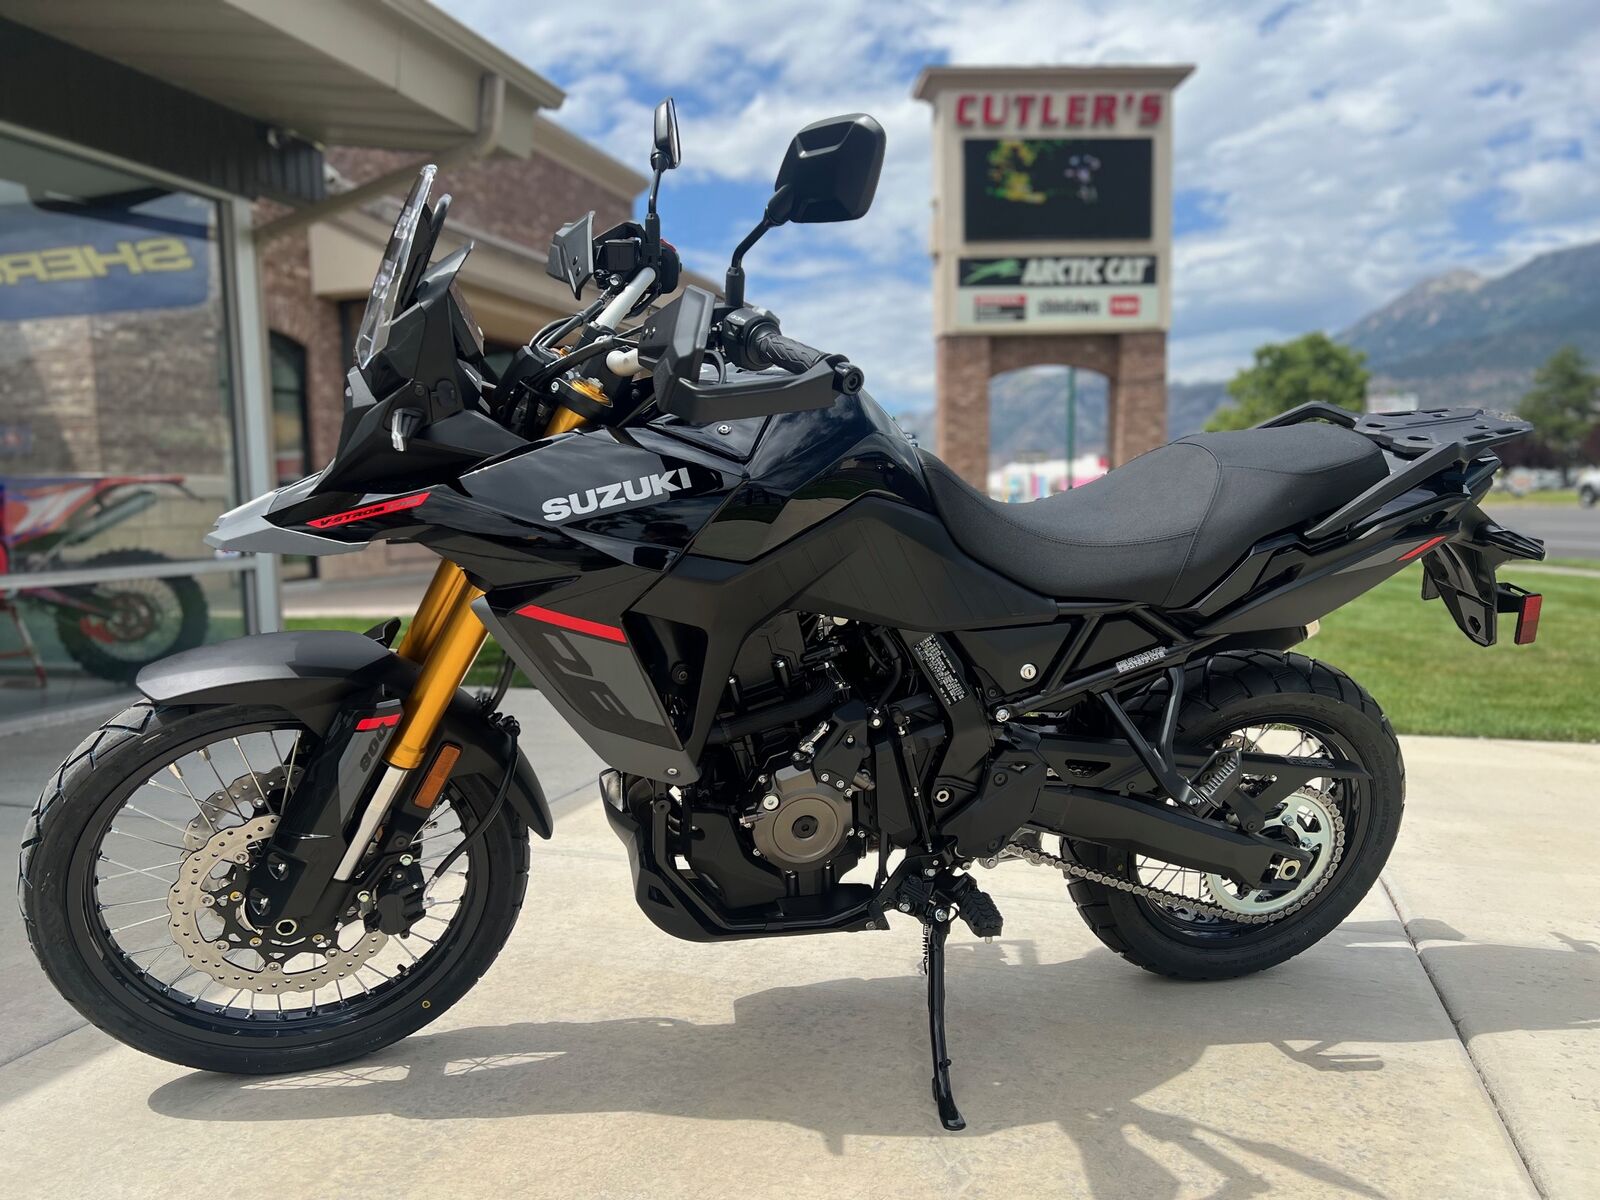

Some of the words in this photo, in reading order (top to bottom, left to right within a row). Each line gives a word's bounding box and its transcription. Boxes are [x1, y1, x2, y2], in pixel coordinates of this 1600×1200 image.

[956, 94, 1163, 127] CUTLER'S
[1021, 258, 1104, 284] ARCTIC
[1104, 257, 1149, 283] CAT
[541, 467, 693, 521] SUZUKI
[320, 506, 385, 526] V-STROM
[360, 722, 388, 773] 800
